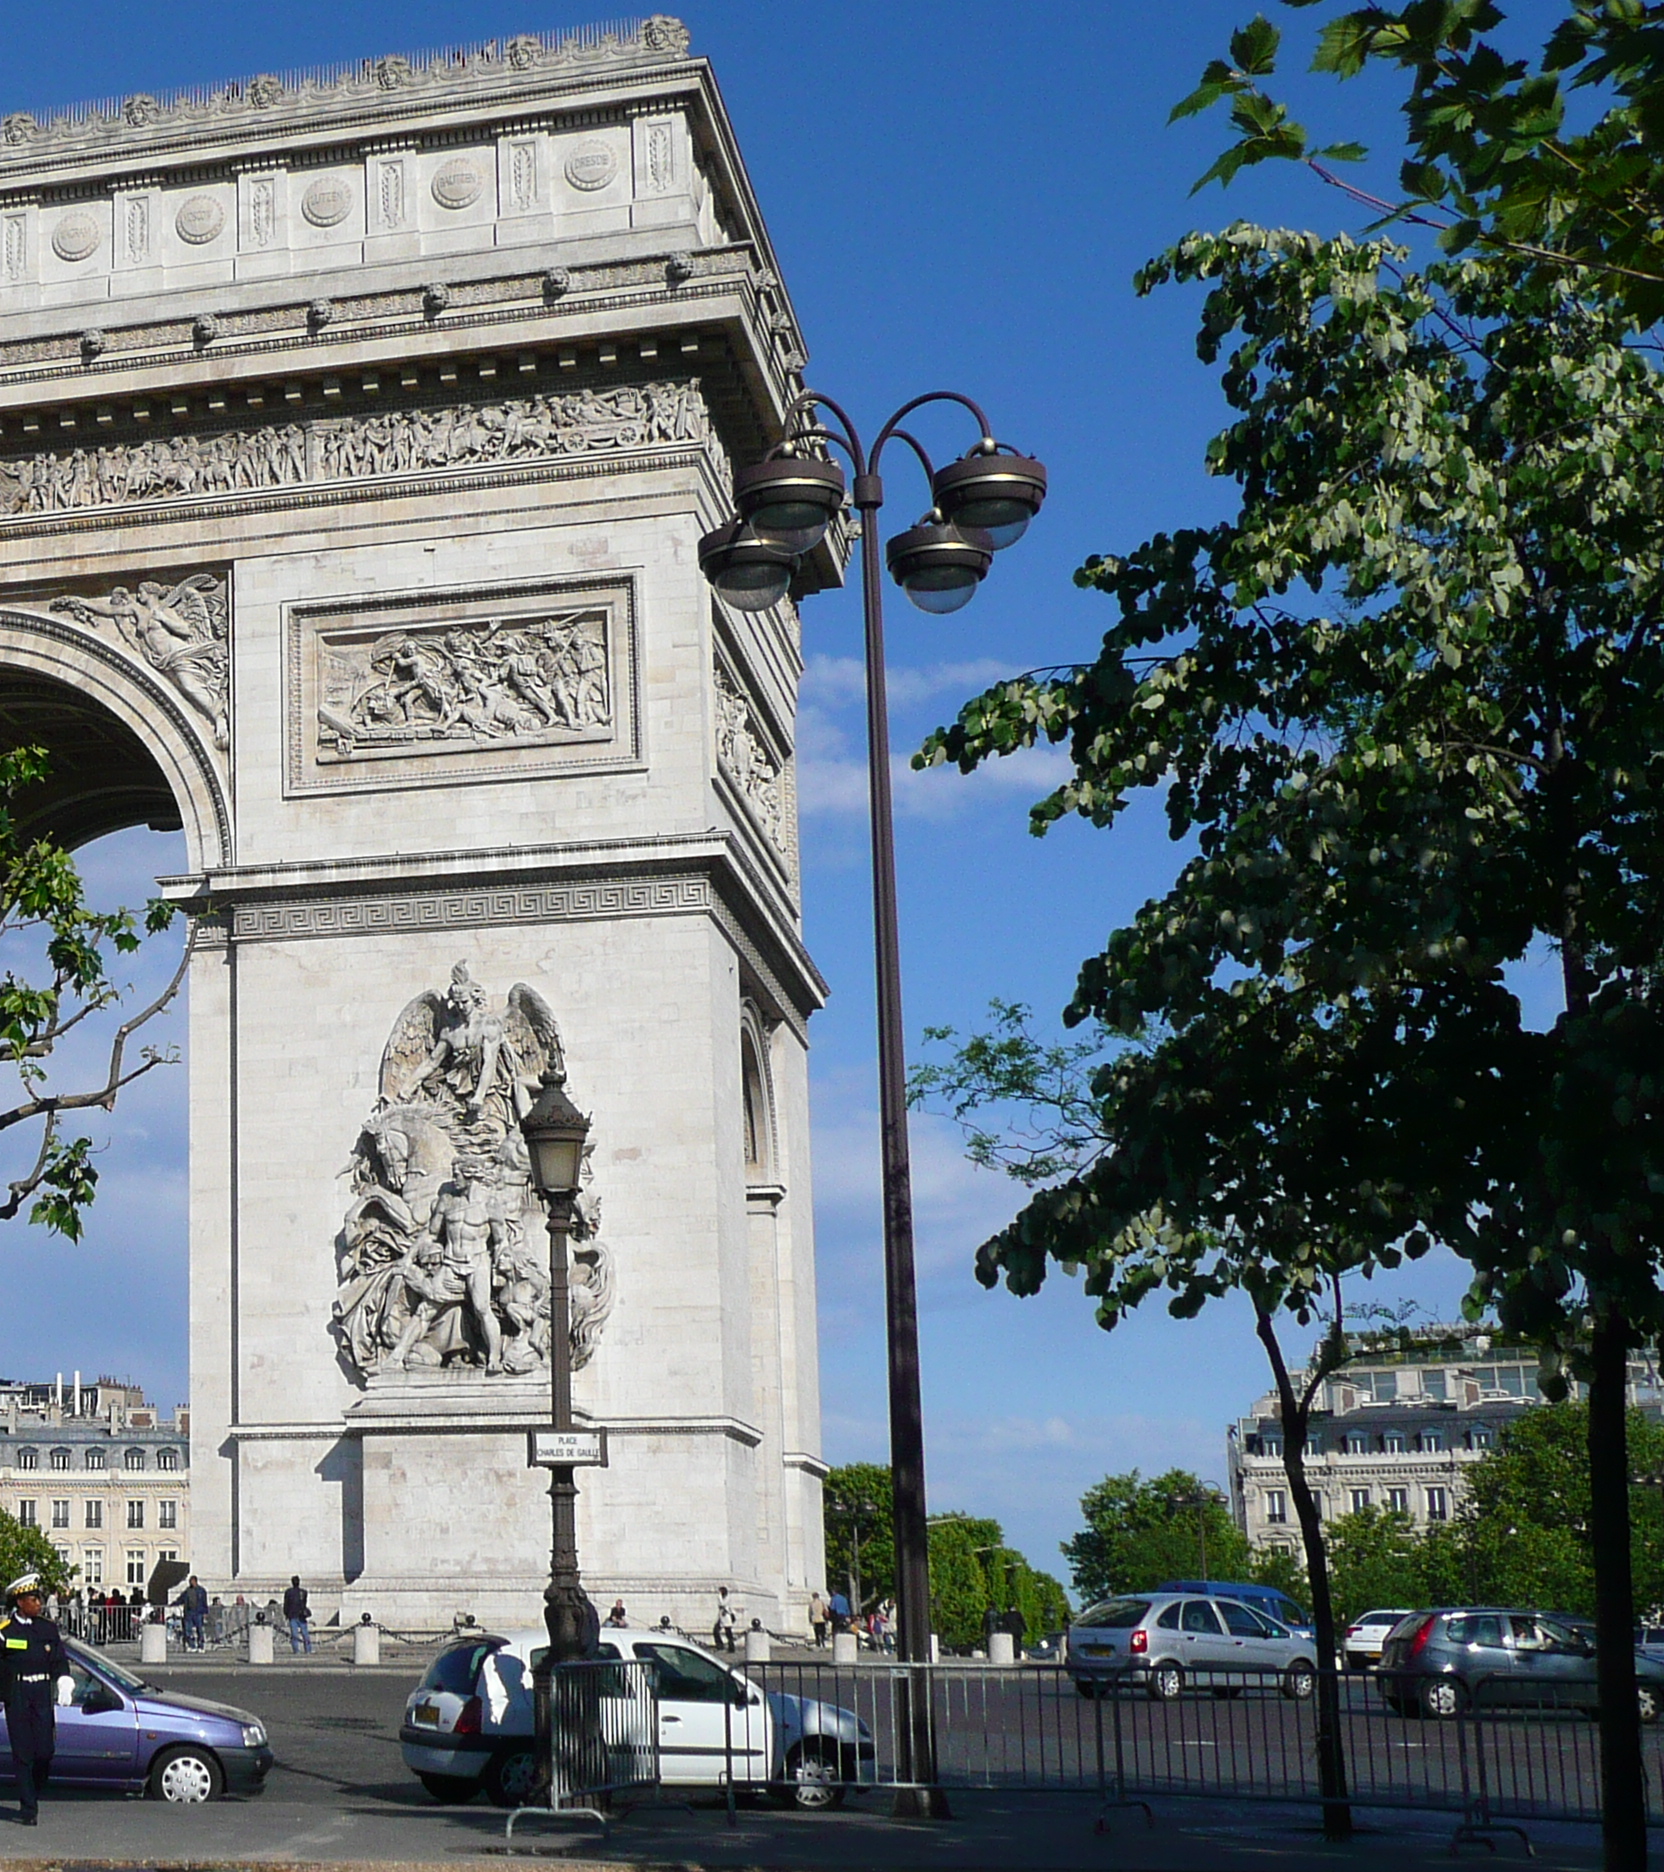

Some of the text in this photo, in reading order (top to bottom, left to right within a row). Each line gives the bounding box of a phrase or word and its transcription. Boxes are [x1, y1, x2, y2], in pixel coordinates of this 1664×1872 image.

[558, 1436, 578, 1445] PLACE
[536, 1448, 600, 1457] CHARLES DE GAULLE
